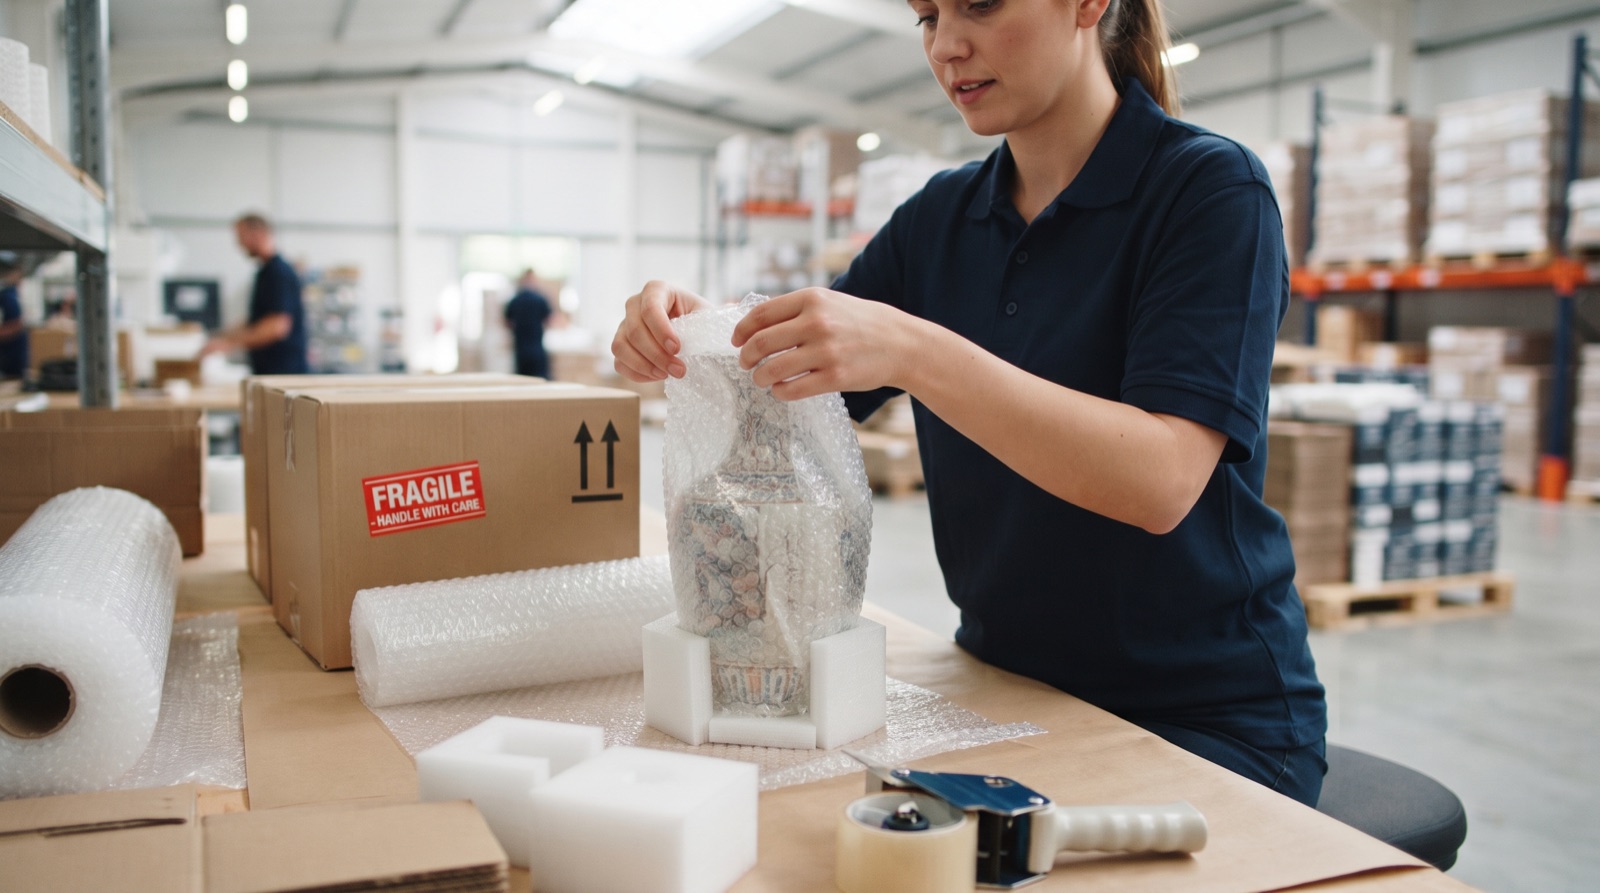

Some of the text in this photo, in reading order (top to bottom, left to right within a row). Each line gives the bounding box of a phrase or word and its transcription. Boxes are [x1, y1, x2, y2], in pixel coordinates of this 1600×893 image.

[372, 471, 475, 511] FRAGILE
[377, 508, 420, 527] HANDLE
[421, 503, 450, 519] WITH
[451, 498, 480, 513] CARE
